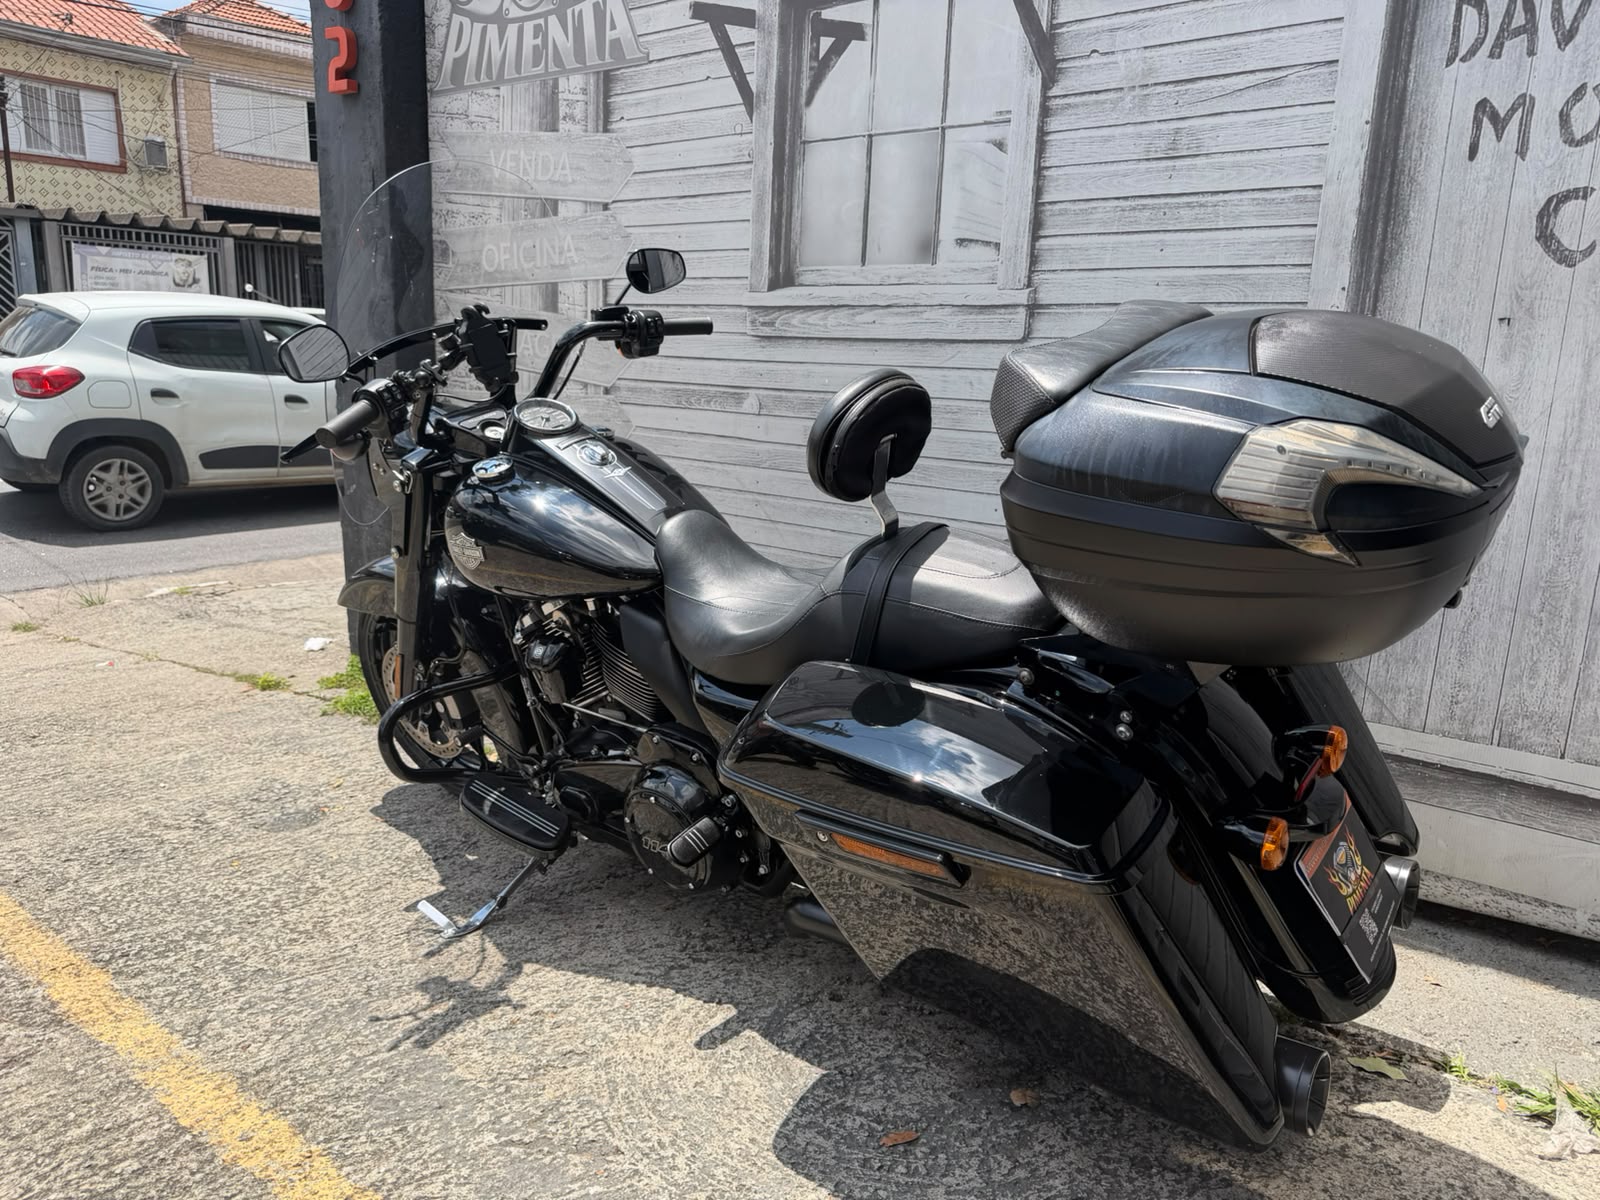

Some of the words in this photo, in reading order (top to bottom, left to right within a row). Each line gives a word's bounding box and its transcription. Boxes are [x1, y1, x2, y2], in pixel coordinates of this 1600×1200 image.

[324, 0, 358, 95] 2
[433, 0, 647, 91] PIMENTA
[490, 149, 573, 183] VENDA
[90, 265, 114, 273] FÍSICA
[137, 268, 169, 277] JURÍDICA
[482, 233, 578, 273] OFICINA
[1345, 865, 1374, 916] PIMENTA
